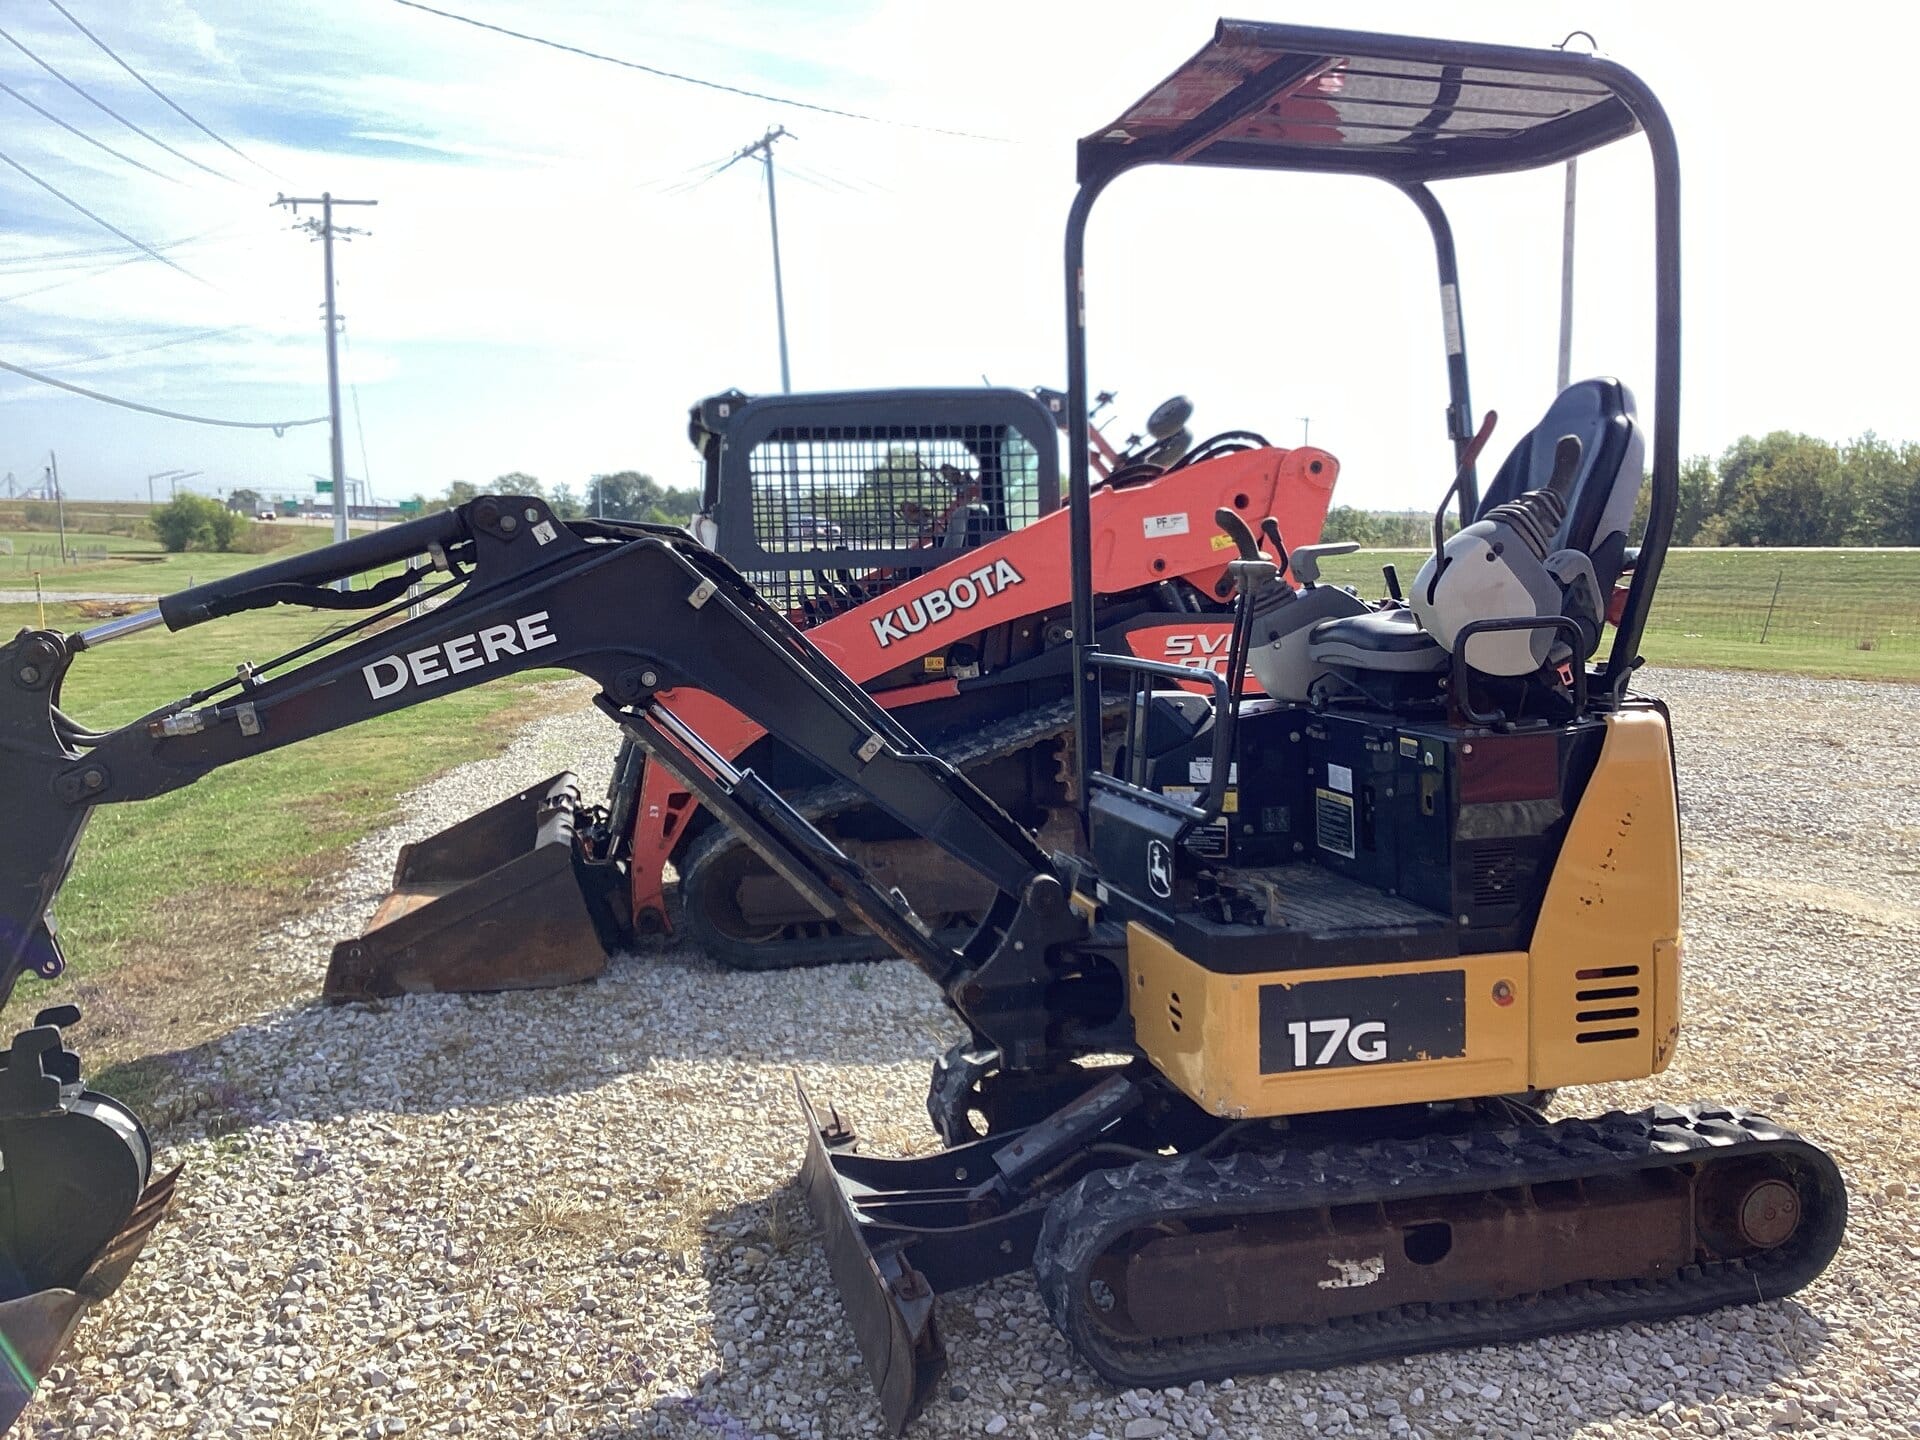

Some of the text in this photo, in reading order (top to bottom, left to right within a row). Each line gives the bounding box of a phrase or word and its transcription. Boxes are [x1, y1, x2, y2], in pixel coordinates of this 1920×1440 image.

[870, 558, 1024, 648] KUBOTA
[362, 610, 557, 700] DEERE
[1288, 1018, 1387, 1067] 17G
